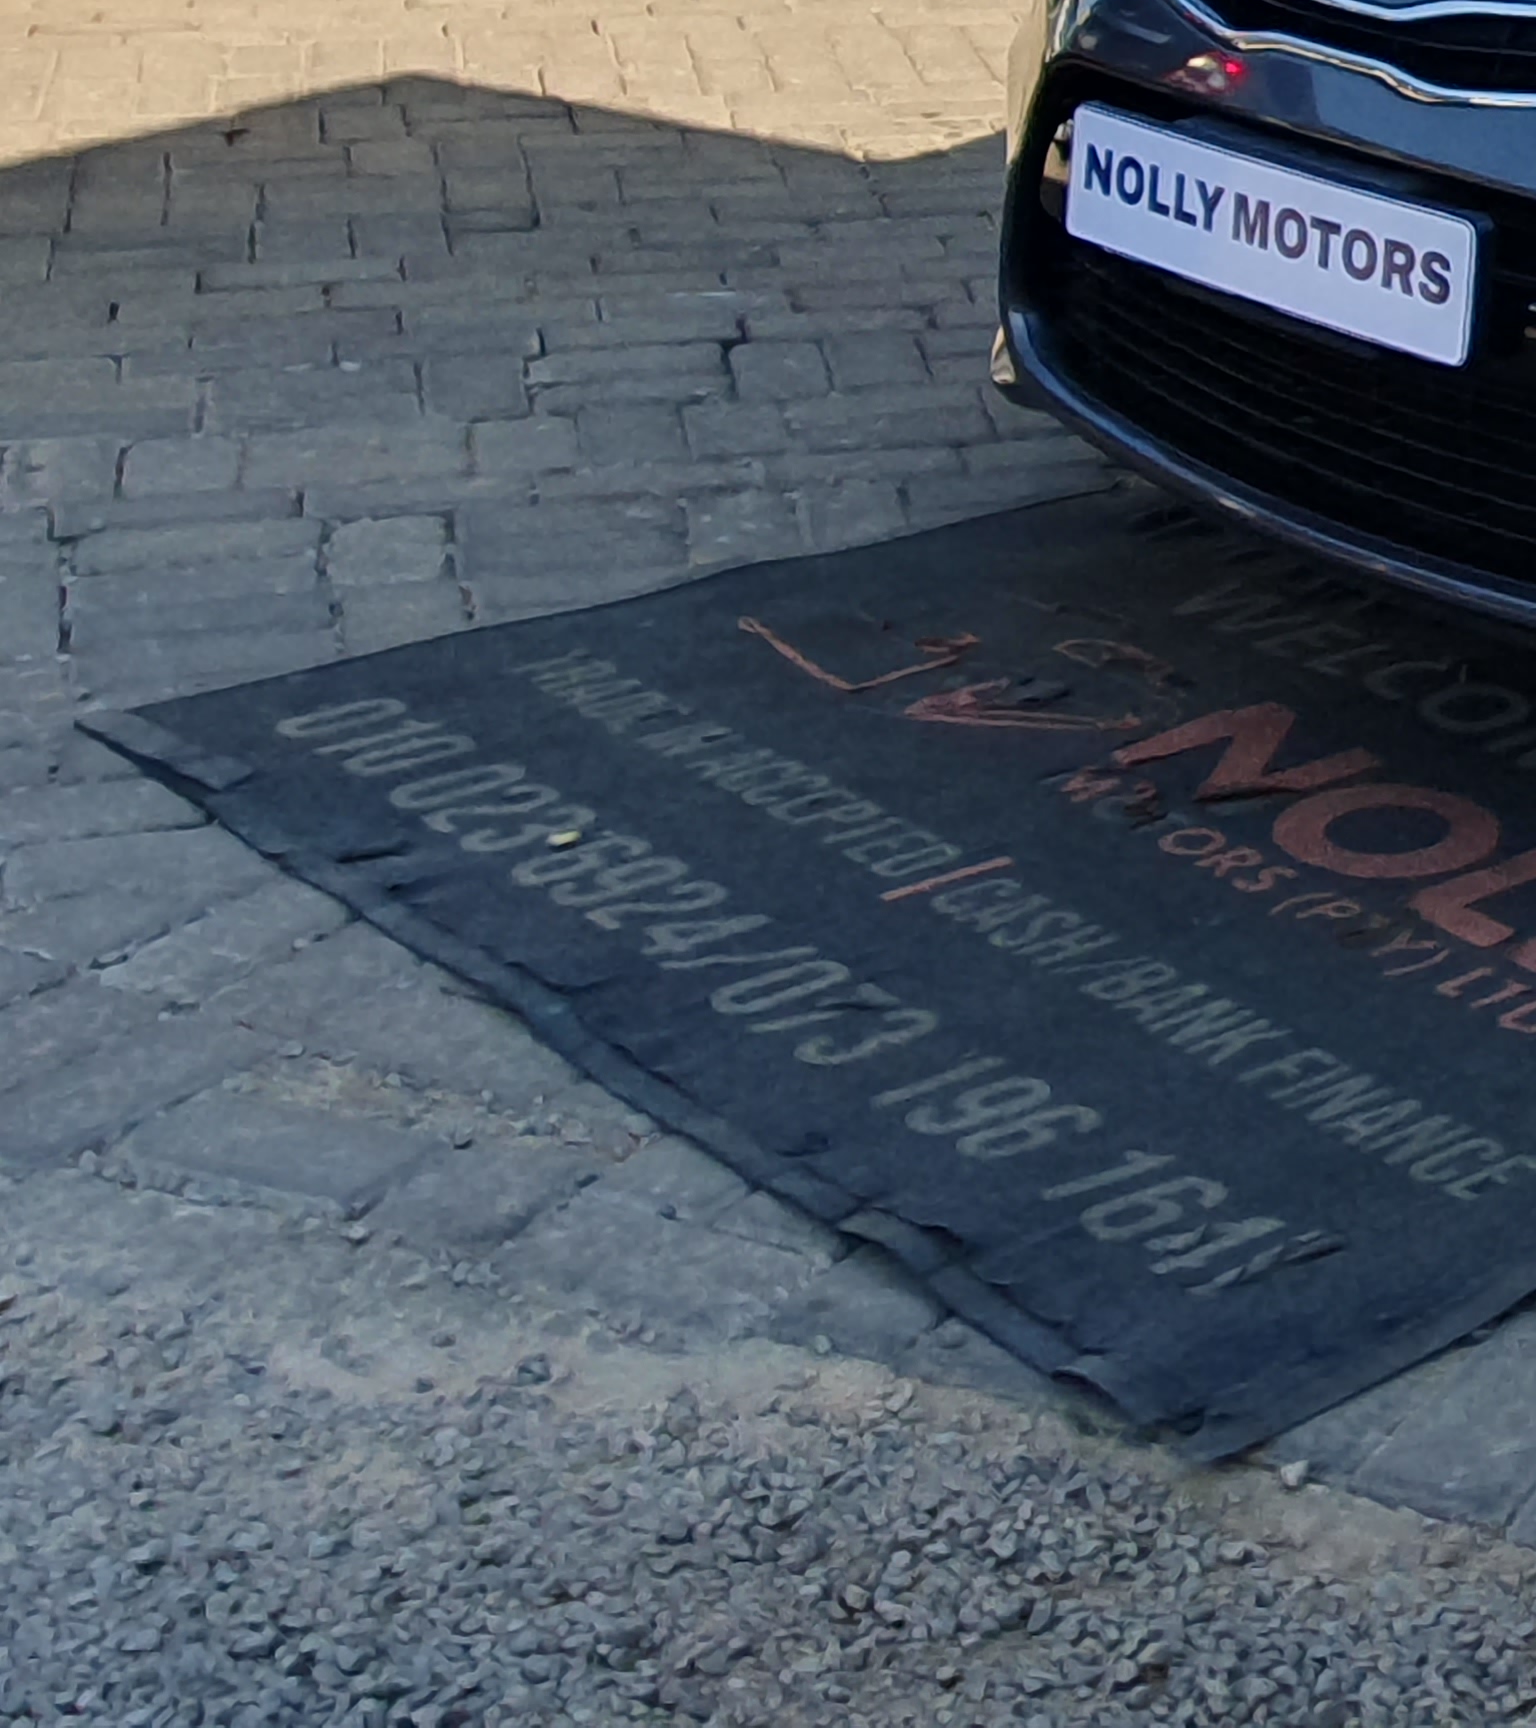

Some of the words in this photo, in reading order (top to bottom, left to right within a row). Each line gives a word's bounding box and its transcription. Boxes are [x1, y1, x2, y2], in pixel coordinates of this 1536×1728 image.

[1083, 143, 1225, 233] NOLLY
[1231, 191, 1453, 305] MOTORS
[686, 748, 963, 878] ACCEPTED
[275, 697, 478, 777] 010
[388, 763, 598, 853] 023
[869, 1051, 1099, 1158] 196
[1268, 891, 1450, 977] (PY)
